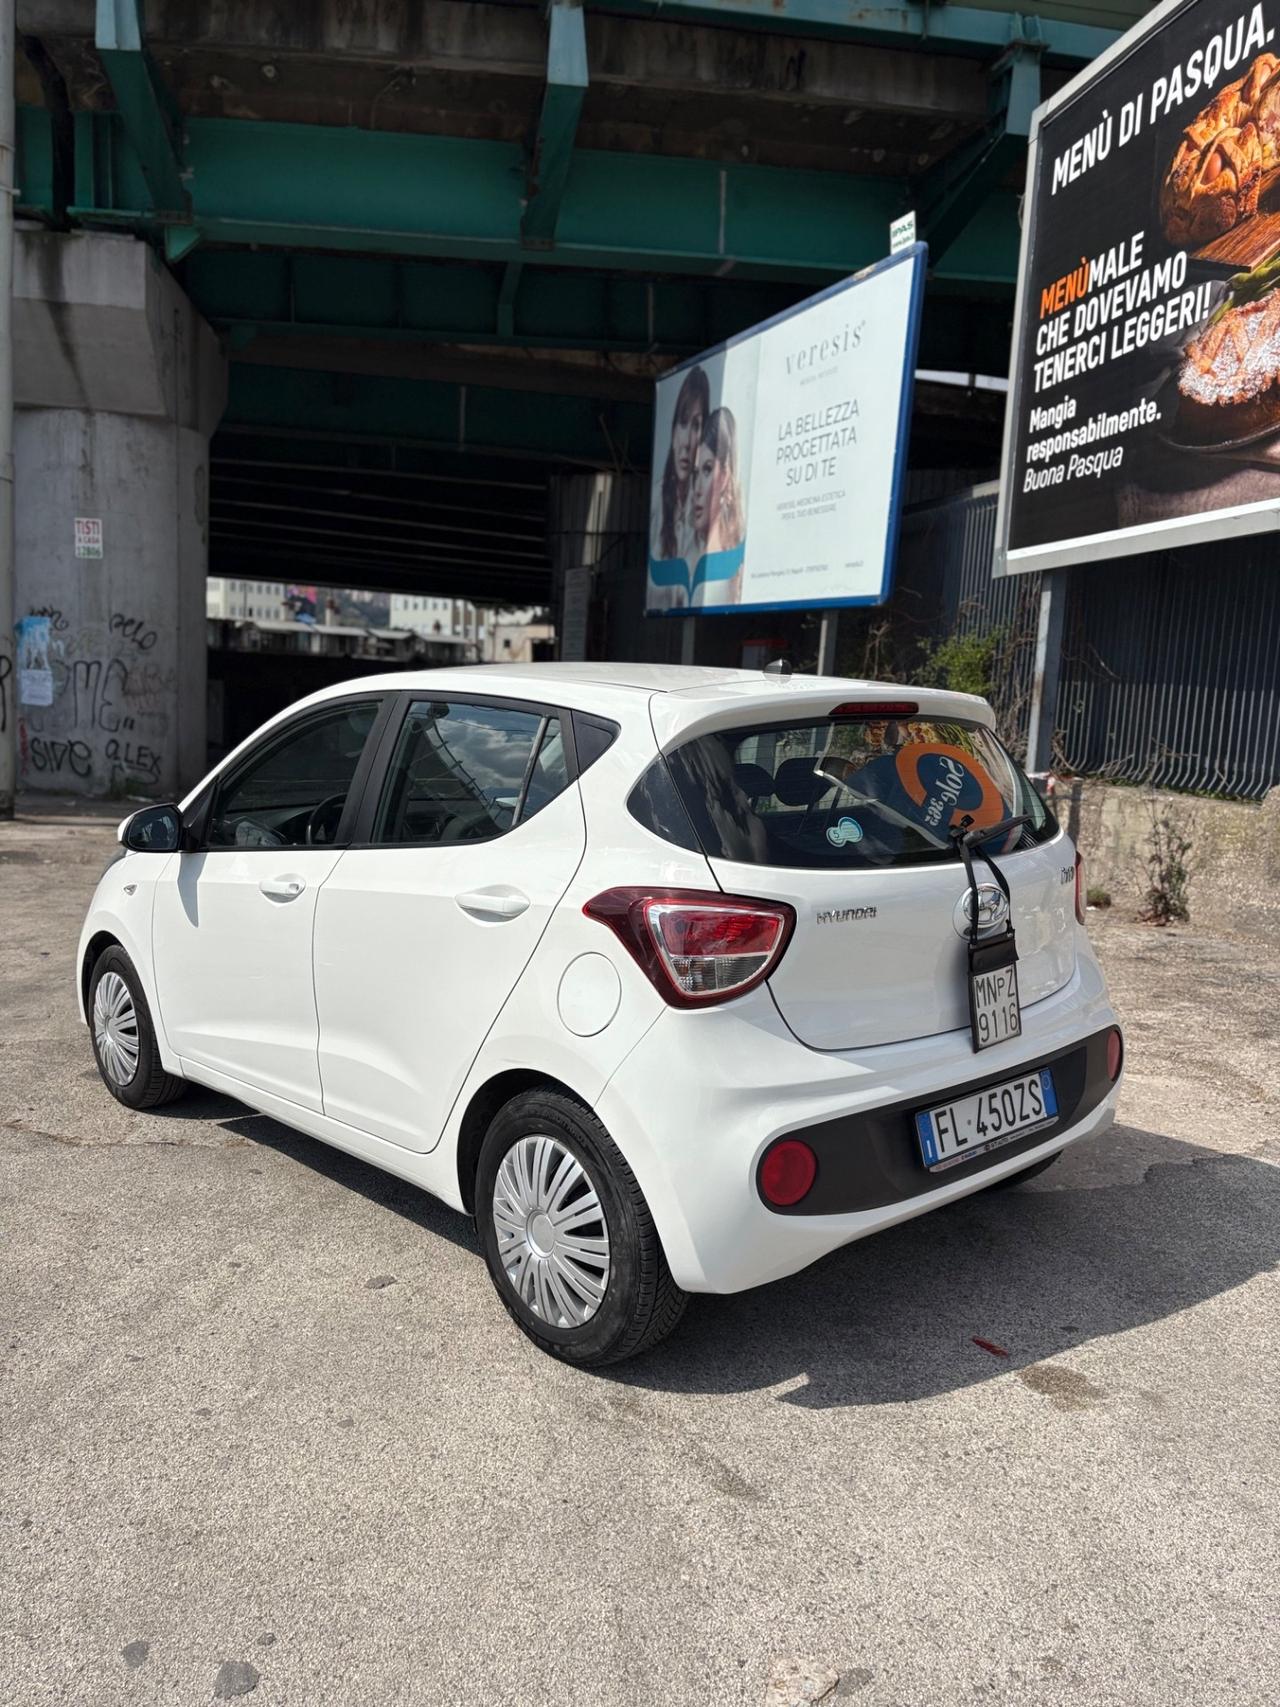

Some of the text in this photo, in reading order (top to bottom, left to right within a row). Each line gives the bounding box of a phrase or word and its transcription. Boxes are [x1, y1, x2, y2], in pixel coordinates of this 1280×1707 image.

[1051, 2, 1275, 196] MENÙ DI PASQUA.
[1039, 231, 1144, 319] MENÙMALE
[1035, 250, 1187, 356] CHE DOVEVAMO
[1033, 282, 1211, 393] TENERCI LEGGERI!
[778, 399, 860, 441] LA BELLEZZA
[1026, 400, 1161, 463] responsabilmente.
[1029, 395, 1076, 433] Mangia
[775, 425, 857, 465] PROGETTATA
[786, 456, 837, 486] SU DI TE
[1023, 446, 1124, 493] Buona Pasqua
[816, 906, 877, 925] HYUNDAI
[978, 1002, 1018, 1042] 9116
[934, 1107, 968, 1153] FL
[976, 1079, 1043, 1136] 450ZS
